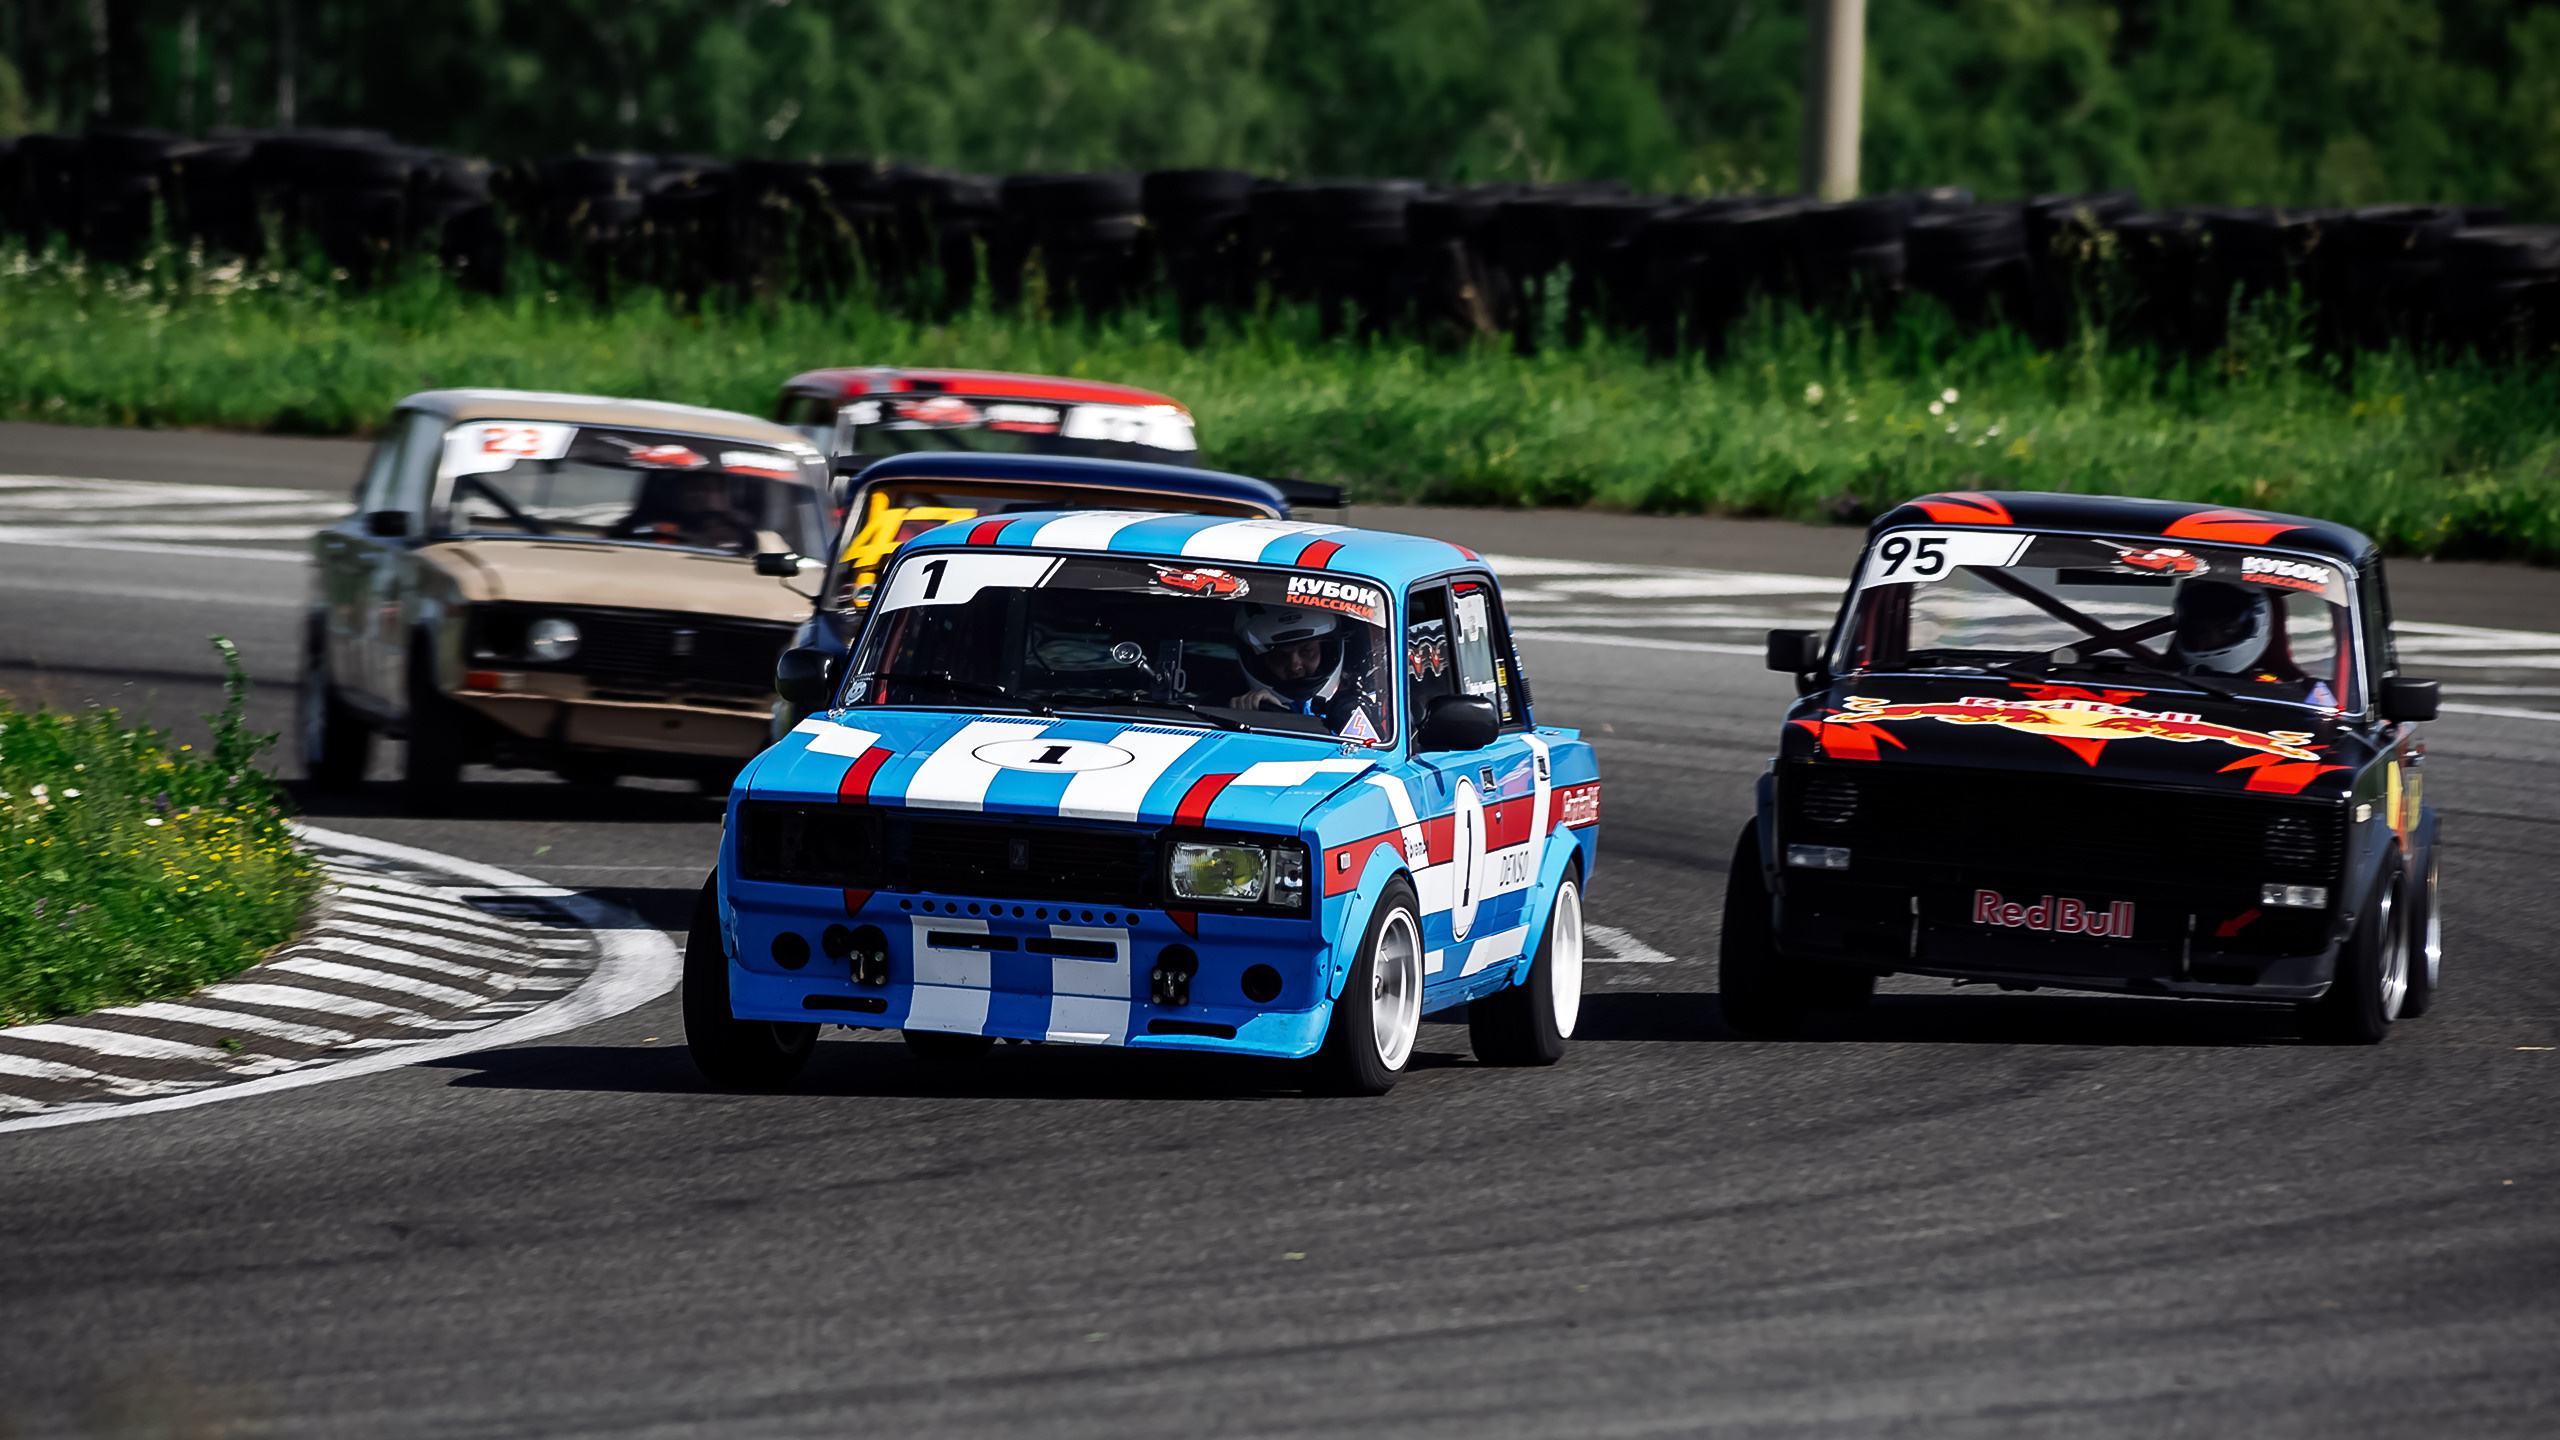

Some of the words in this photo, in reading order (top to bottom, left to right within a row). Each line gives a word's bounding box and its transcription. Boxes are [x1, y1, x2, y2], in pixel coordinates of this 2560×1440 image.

[1881, 536, 1949, 577] 95
[922, 559, 948, 600] 1
[1287, 577, 1378, 607] КУБОК
[1286, 594, 1374, 618] КЛАССИКИ
[1029, 745, 1072, 764] 1
[1462, 809, 1472, 907] 1
[1499, 850, 1529, 887] DENSO
[1972, 889, 2054, 931] Red
[2054, 897, 2135, 938] Bull
